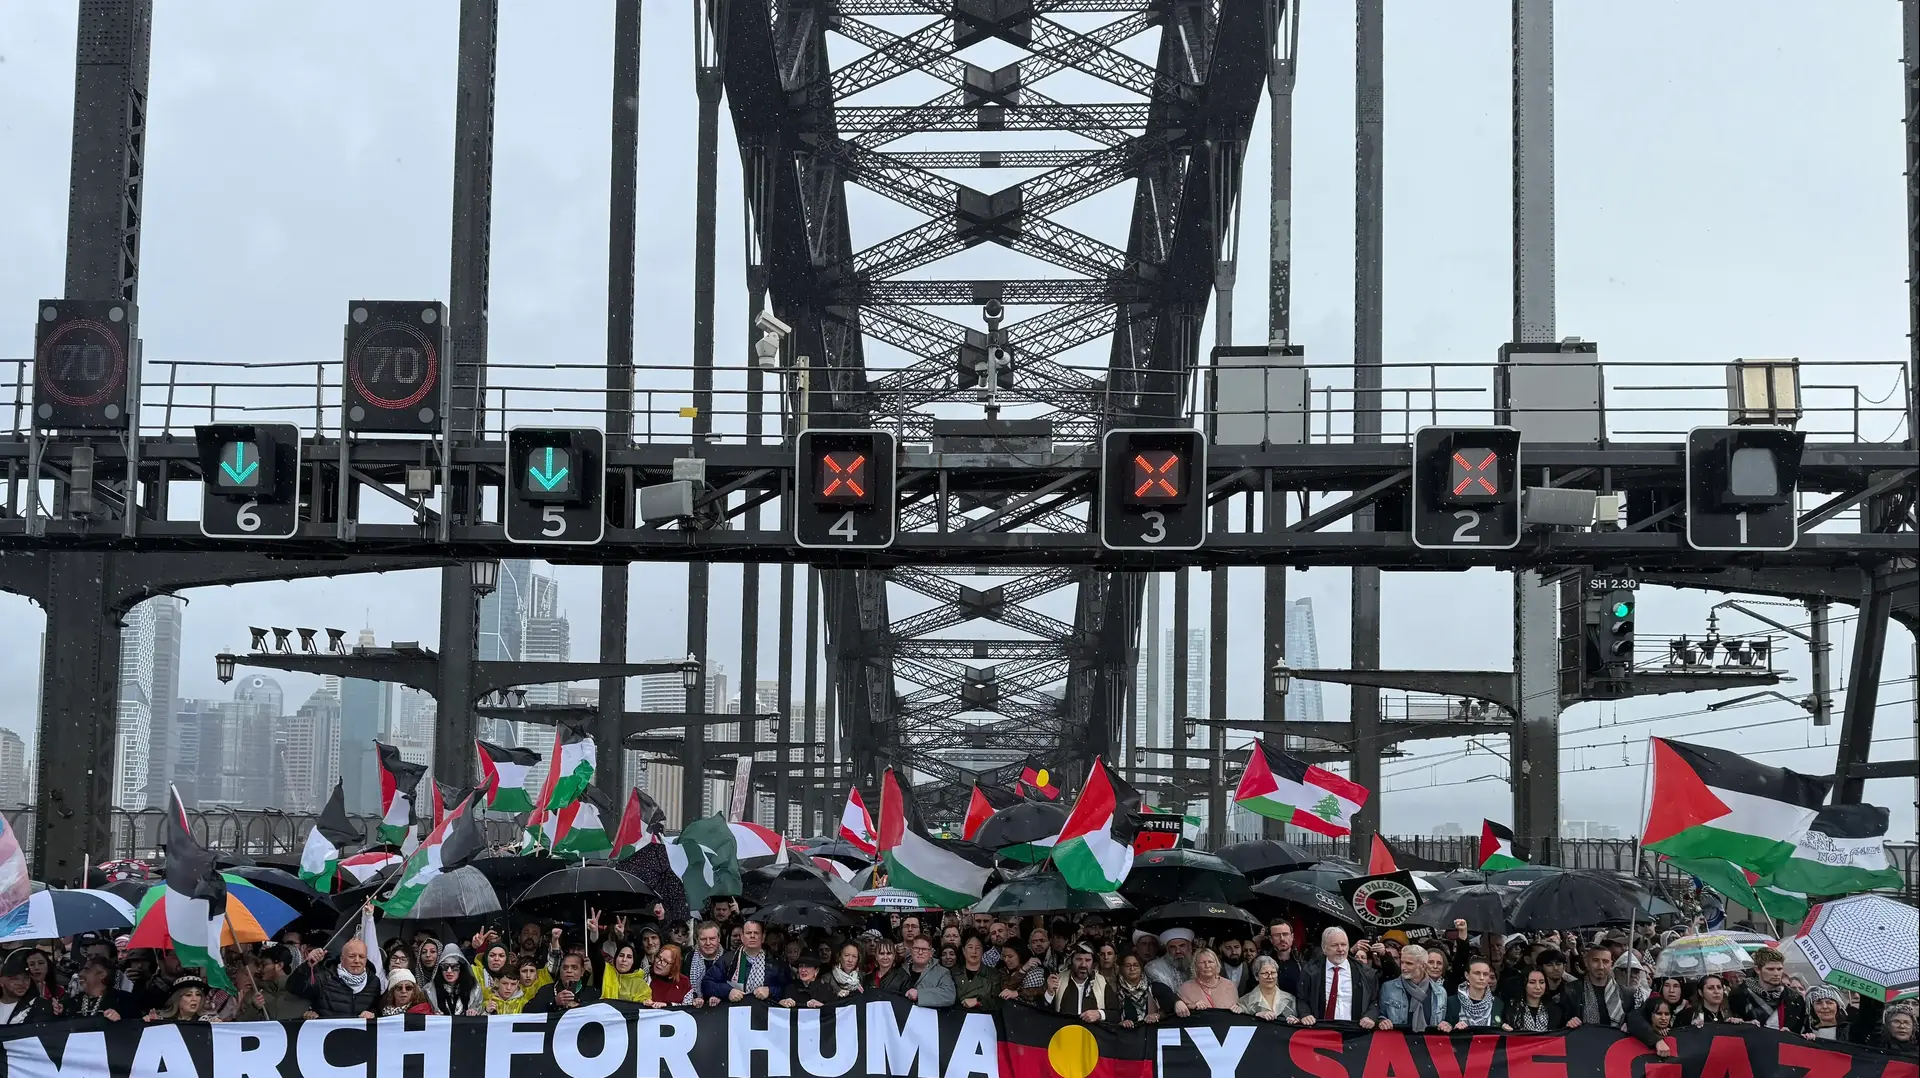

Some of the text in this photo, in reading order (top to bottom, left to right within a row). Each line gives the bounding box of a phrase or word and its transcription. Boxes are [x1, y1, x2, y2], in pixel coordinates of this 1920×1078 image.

[59, 344, 106, 380] 70
[366, 346, 420, 384] 70
[237, 501, 261, 532] 6
[541, 506, 567, 537] 5
[828, 510, 858, 542] 4
[1140, 511, 1167, 543] 3
[1452, 509, 1481, 543] 2
[1733, 512, 1749, 544] 1
[1590, 579, 1636, 589] SH 2.30
[1147, 820, 1181, 830] STINE
[1354, 881, 1412, 907] FREE PALESTINE
[1357, 898, 1416, 926] END APARTHEID
[1801, 939, 1820, 961] RIVER
[1816, 960, 1826, 971] TO
[1837, 974, 1878, 996] THE SEA
[3, 1014, 452, 1078] MARCH
[484, 1003, 700, 1078] FOR
[1289, 1029, 1567, 1078] SAVE
[1604, 1035, 1918, 1078] GAZ
